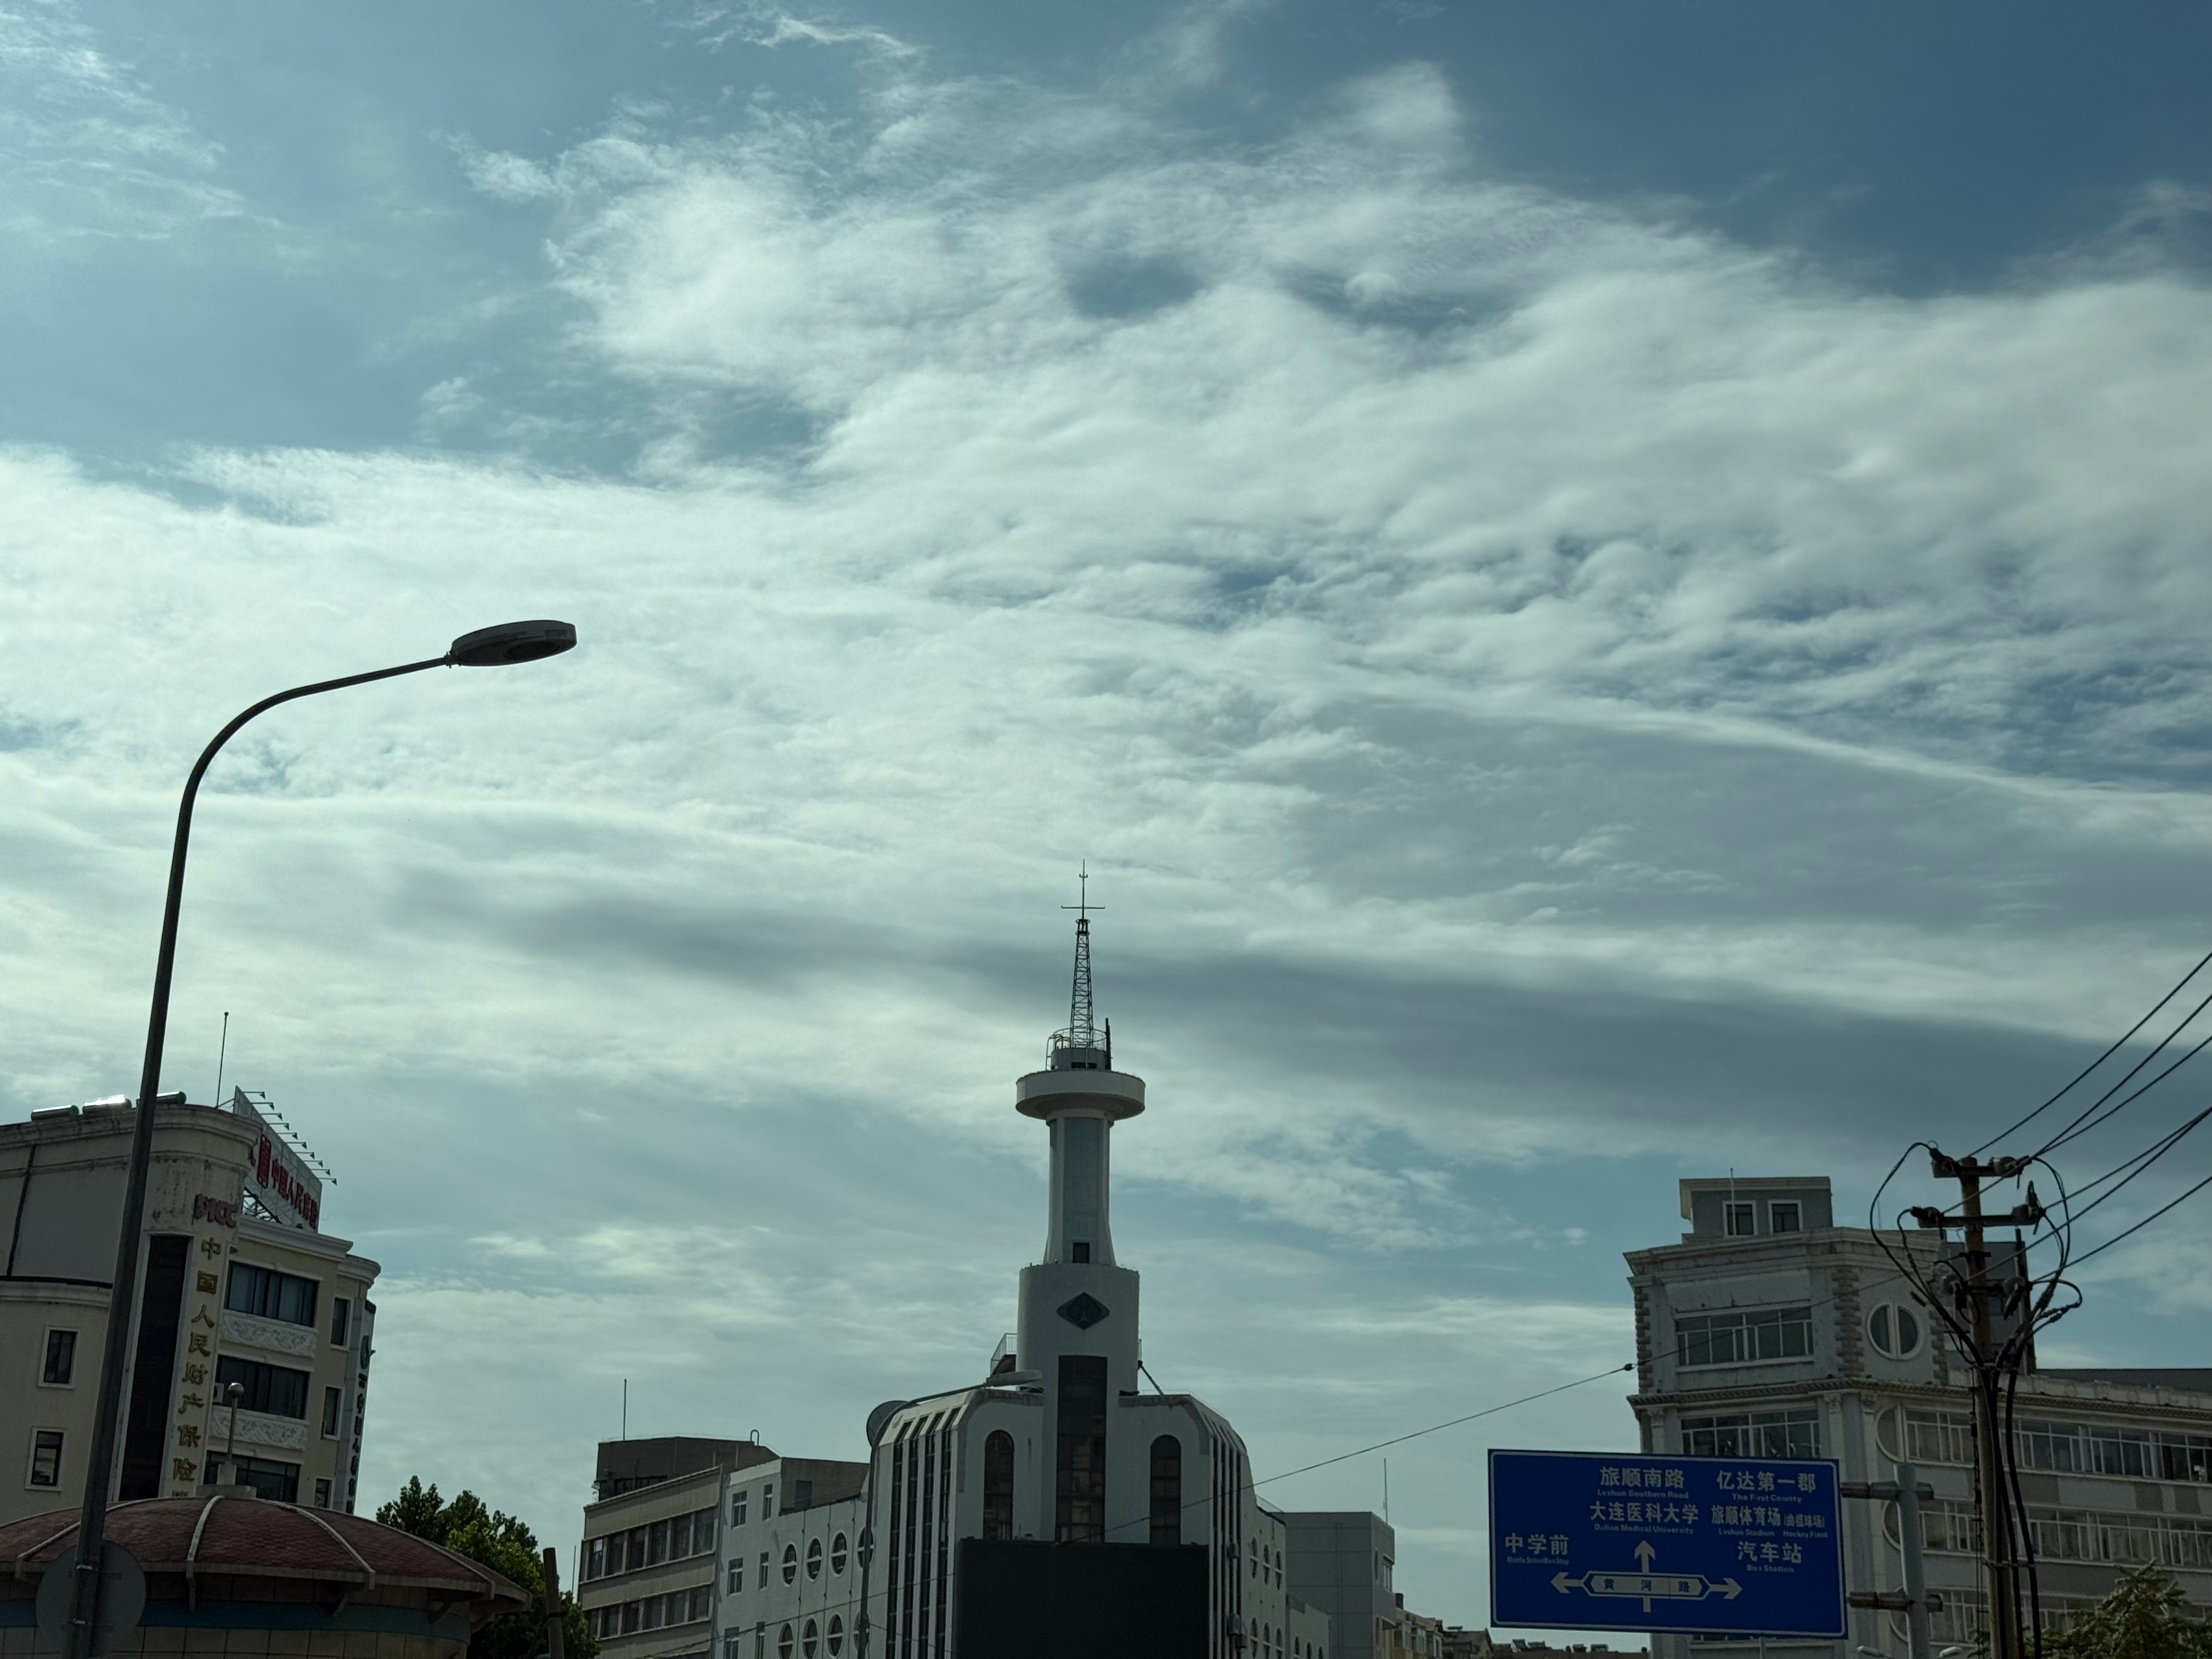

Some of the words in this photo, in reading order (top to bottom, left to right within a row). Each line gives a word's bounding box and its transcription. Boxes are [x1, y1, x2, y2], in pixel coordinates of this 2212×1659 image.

[194, 1194, 238, 1228] PICC
[172, 1237, 221, 1497] 中国人民财产保险
[1600, 1466, 1684, 1489] 旅顺南路
[1717, 1470, 1816, 1493] 亿达第一郡
[1628, 1489, 1666, 1498] Southern
[1668, 1491, 1689, 1499] Road
[1590, 1500, 1699, 1524] 大连医科大学
[1711, 1505, 1780, 1526] 旅顺体育场
[1621, 1524, 1651, 1532] Medical
[1653, 1526, 1694, 1534] University
[1784, 1530, 1808, 1539] Hockey
[1505, 1533, 1569, 1555] 中学前
[1737, 1541, 1802, 1564] 汽车站
[1604, 1579, 1690, 1593] 黄河路
